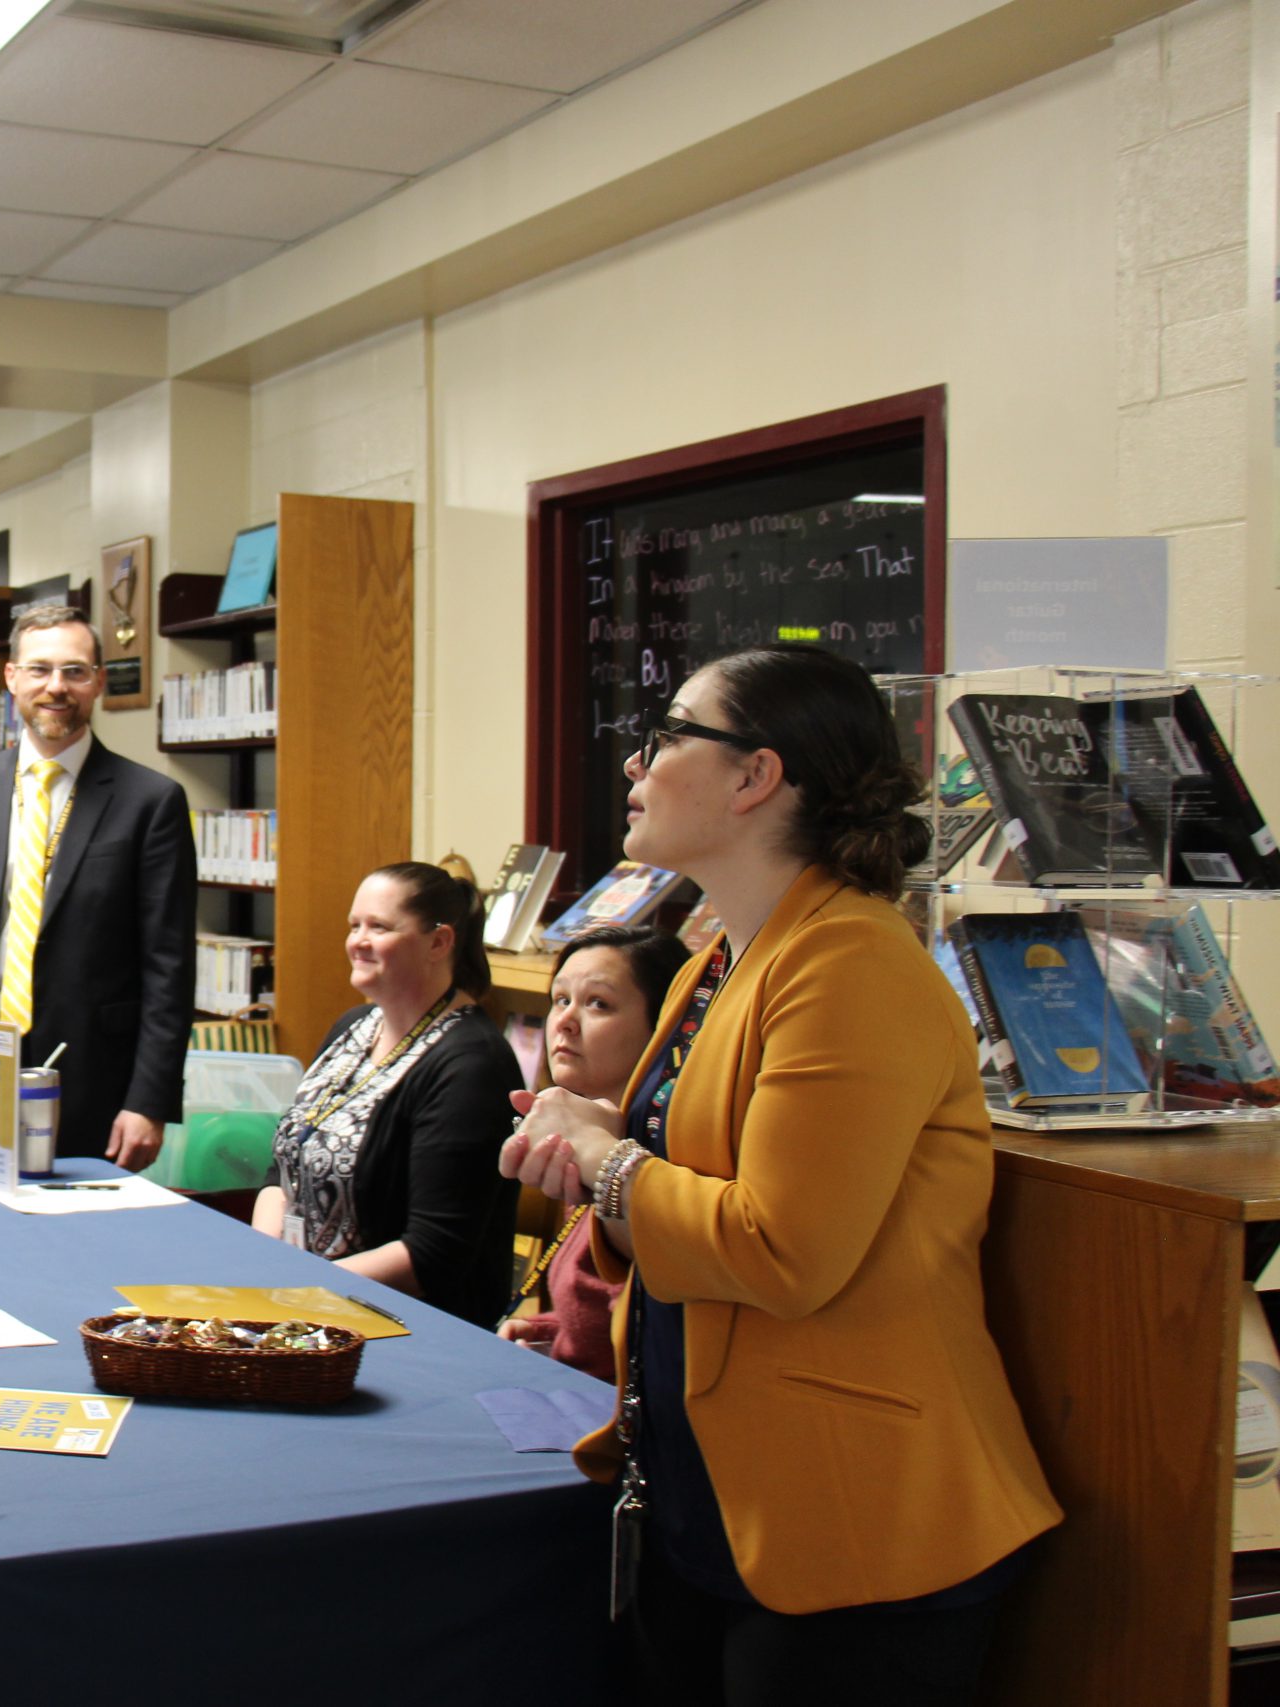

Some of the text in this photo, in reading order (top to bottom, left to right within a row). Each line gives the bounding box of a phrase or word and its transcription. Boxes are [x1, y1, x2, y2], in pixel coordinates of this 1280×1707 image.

[855, 545, 916, 578] That
[641, 648, 671, 699] By
[977, 701, 1094, 753] Keeping
[1006, 735, 1090, 777] Beat
[1218, 984, 1240, 1015] WHAT
[519, 1270, 541, 1296] PINE
[536, 1241, 560, 1272] BUSH
[19, 1401, 72, 1440] WE ARE
